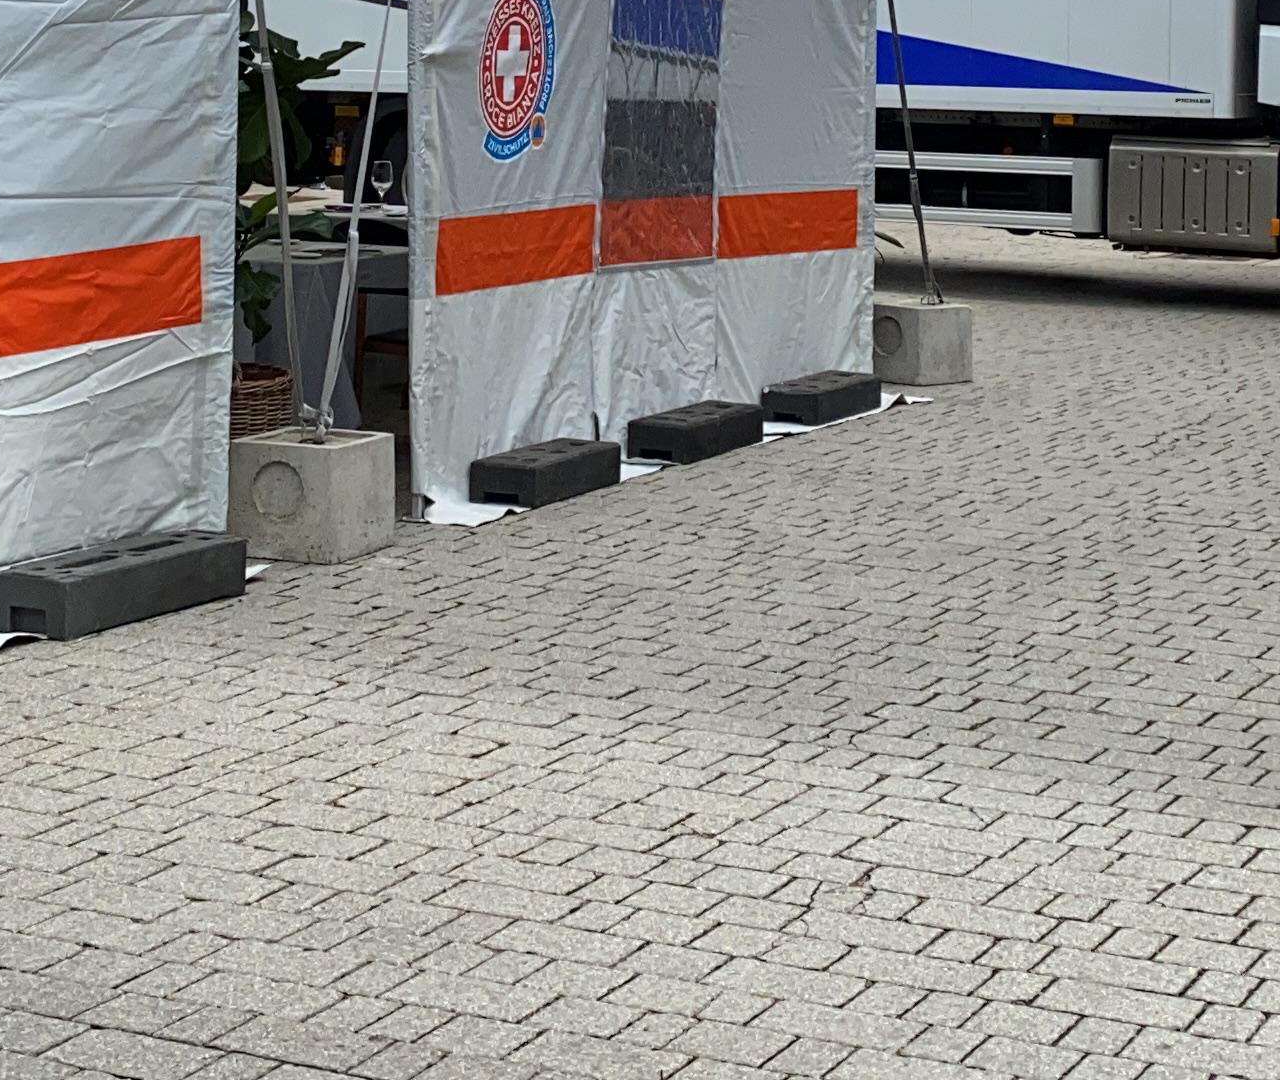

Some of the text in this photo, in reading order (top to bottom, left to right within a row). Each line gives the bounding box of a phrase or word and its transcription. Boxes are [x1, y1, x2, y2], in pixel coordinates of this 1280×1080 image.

[521, 1, 542, 56] KREUZ
[539, 26, 554, 111] PROTEZIONE
[483, 71, 540, 129] CROCE BIANCA
[487, 132, 529, 156] ZIVILSCHUTZ
